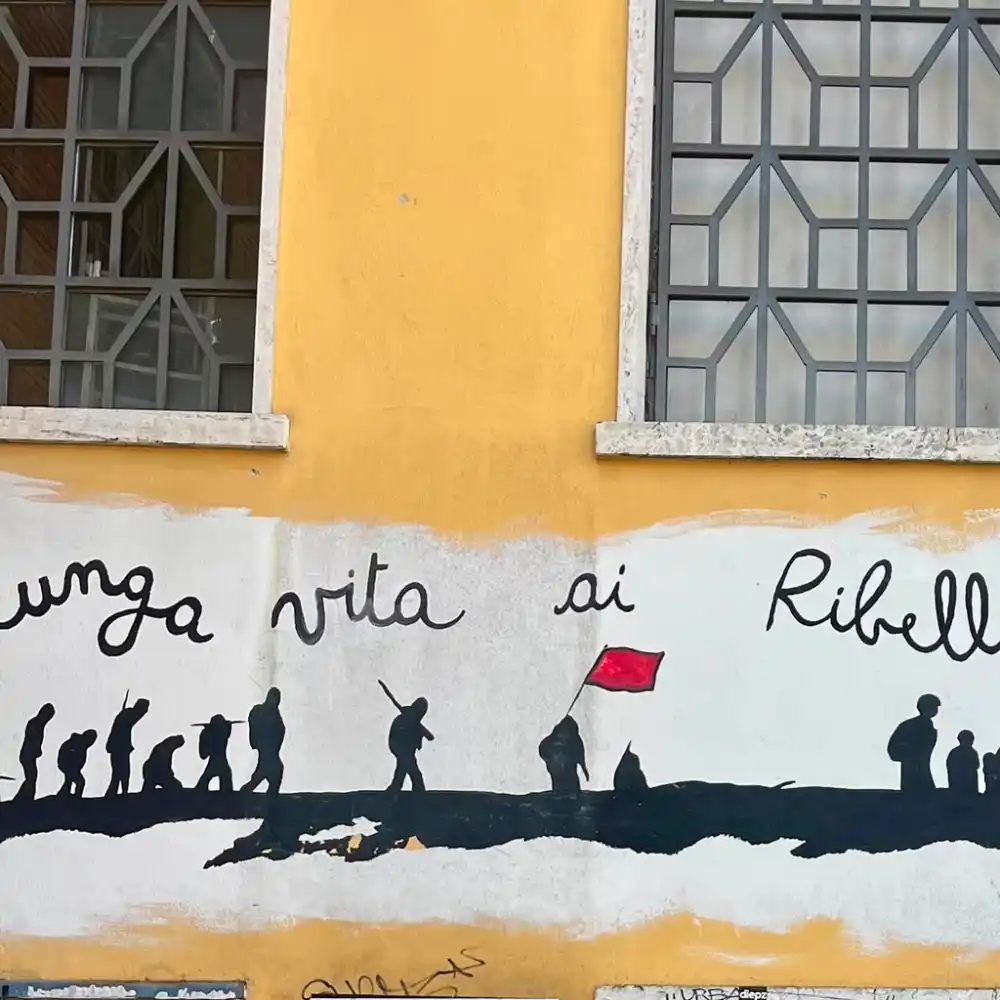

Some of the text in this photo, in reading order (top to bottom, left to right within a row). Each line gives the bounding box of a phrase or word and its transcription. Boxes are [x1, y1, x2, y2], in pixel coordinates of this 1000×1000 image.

[0, 559, 213, 656] unga
[271, 552, 465, 645] vita
[553, 564, 636, 614] ai
[740, 990, 767, 1000] diepz
